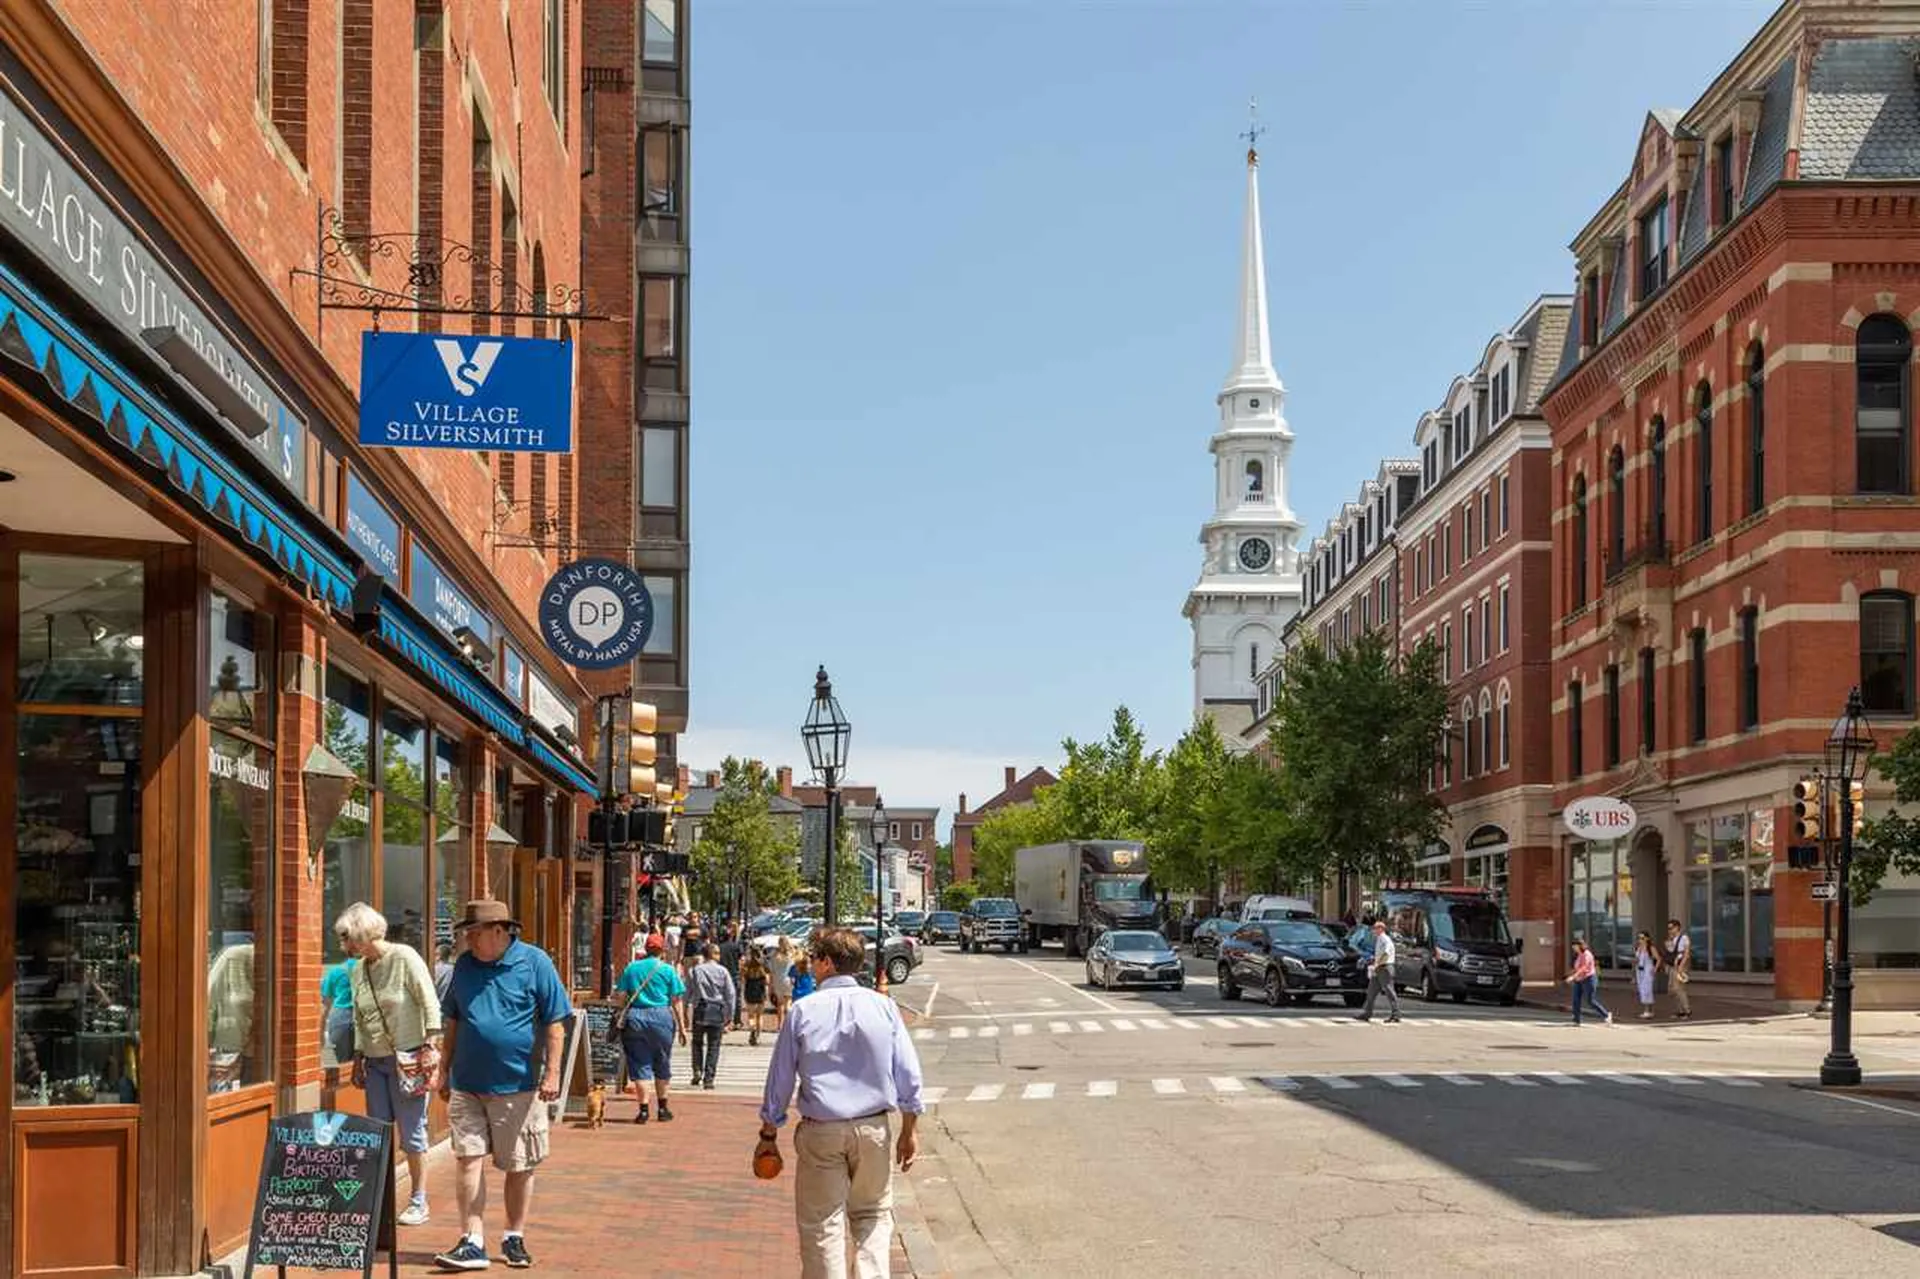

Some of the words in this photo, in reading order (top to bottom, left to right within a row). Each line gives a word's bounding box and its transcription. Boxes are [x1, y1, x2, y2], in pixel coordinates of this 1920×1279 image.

[414, 401, 520, 424] VILLAGE
[386, 421, 545, 446] SILVERSMITH
[549, 565, 645, 606] DANFORTH
[578, 600, 618, 627] DP
[549, 619, 576, 656] METAL
[577, 647, 594, 661] BY
[594, 642, 630, 661] HAND
[626, 619, 644, 645] USA
[1595, 810, 1630, 827] UBS
[297, 1147, 348, 1164] AUGUST
[283, 1158, 358, 1178] BIRTHSTONE
